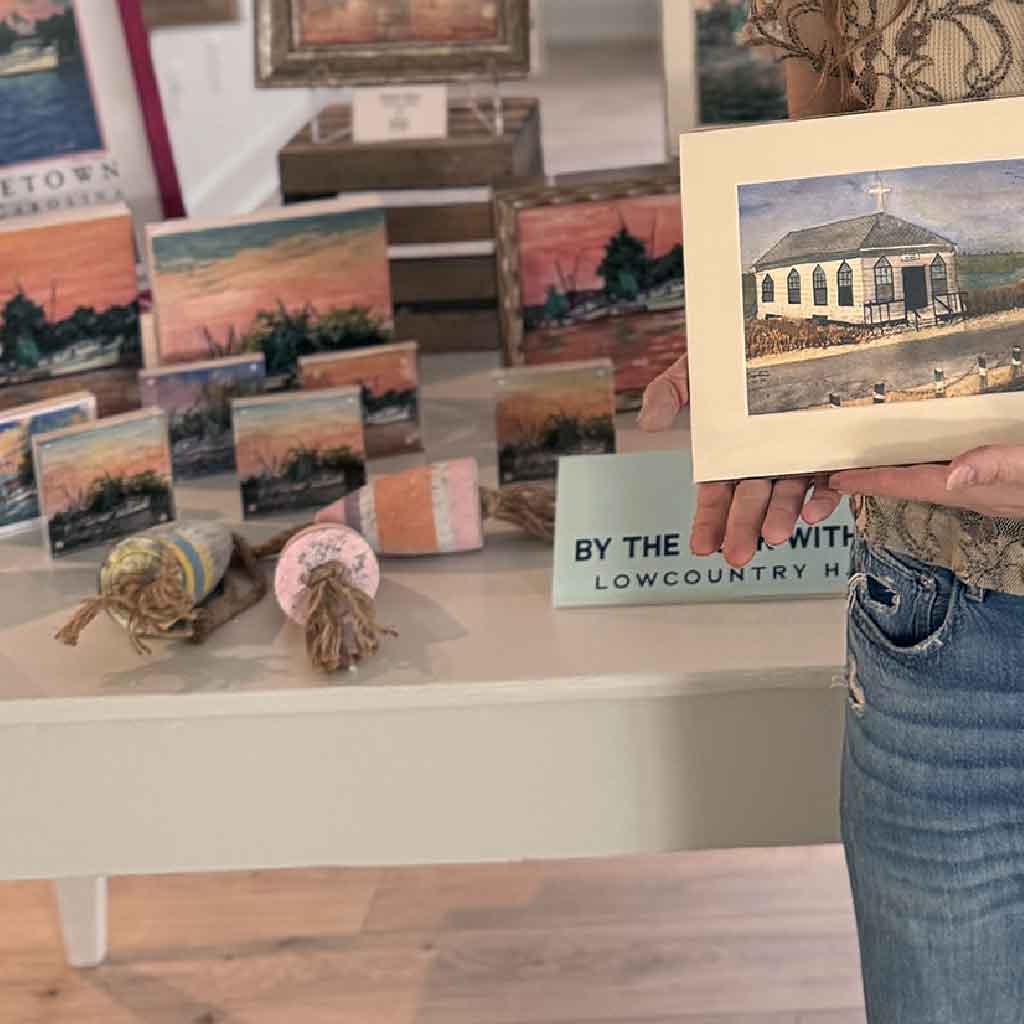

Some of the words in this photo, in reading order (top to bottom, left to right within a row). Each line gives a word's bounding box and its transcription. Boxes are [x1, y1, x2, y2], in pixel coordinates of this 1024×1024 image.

[575, 537, 612, 562] BY
[622, 532, 680, 558] THE
[789, 525, 855, 549] WITH
[595, 563, 806, 590] LOWCOUNTRY
